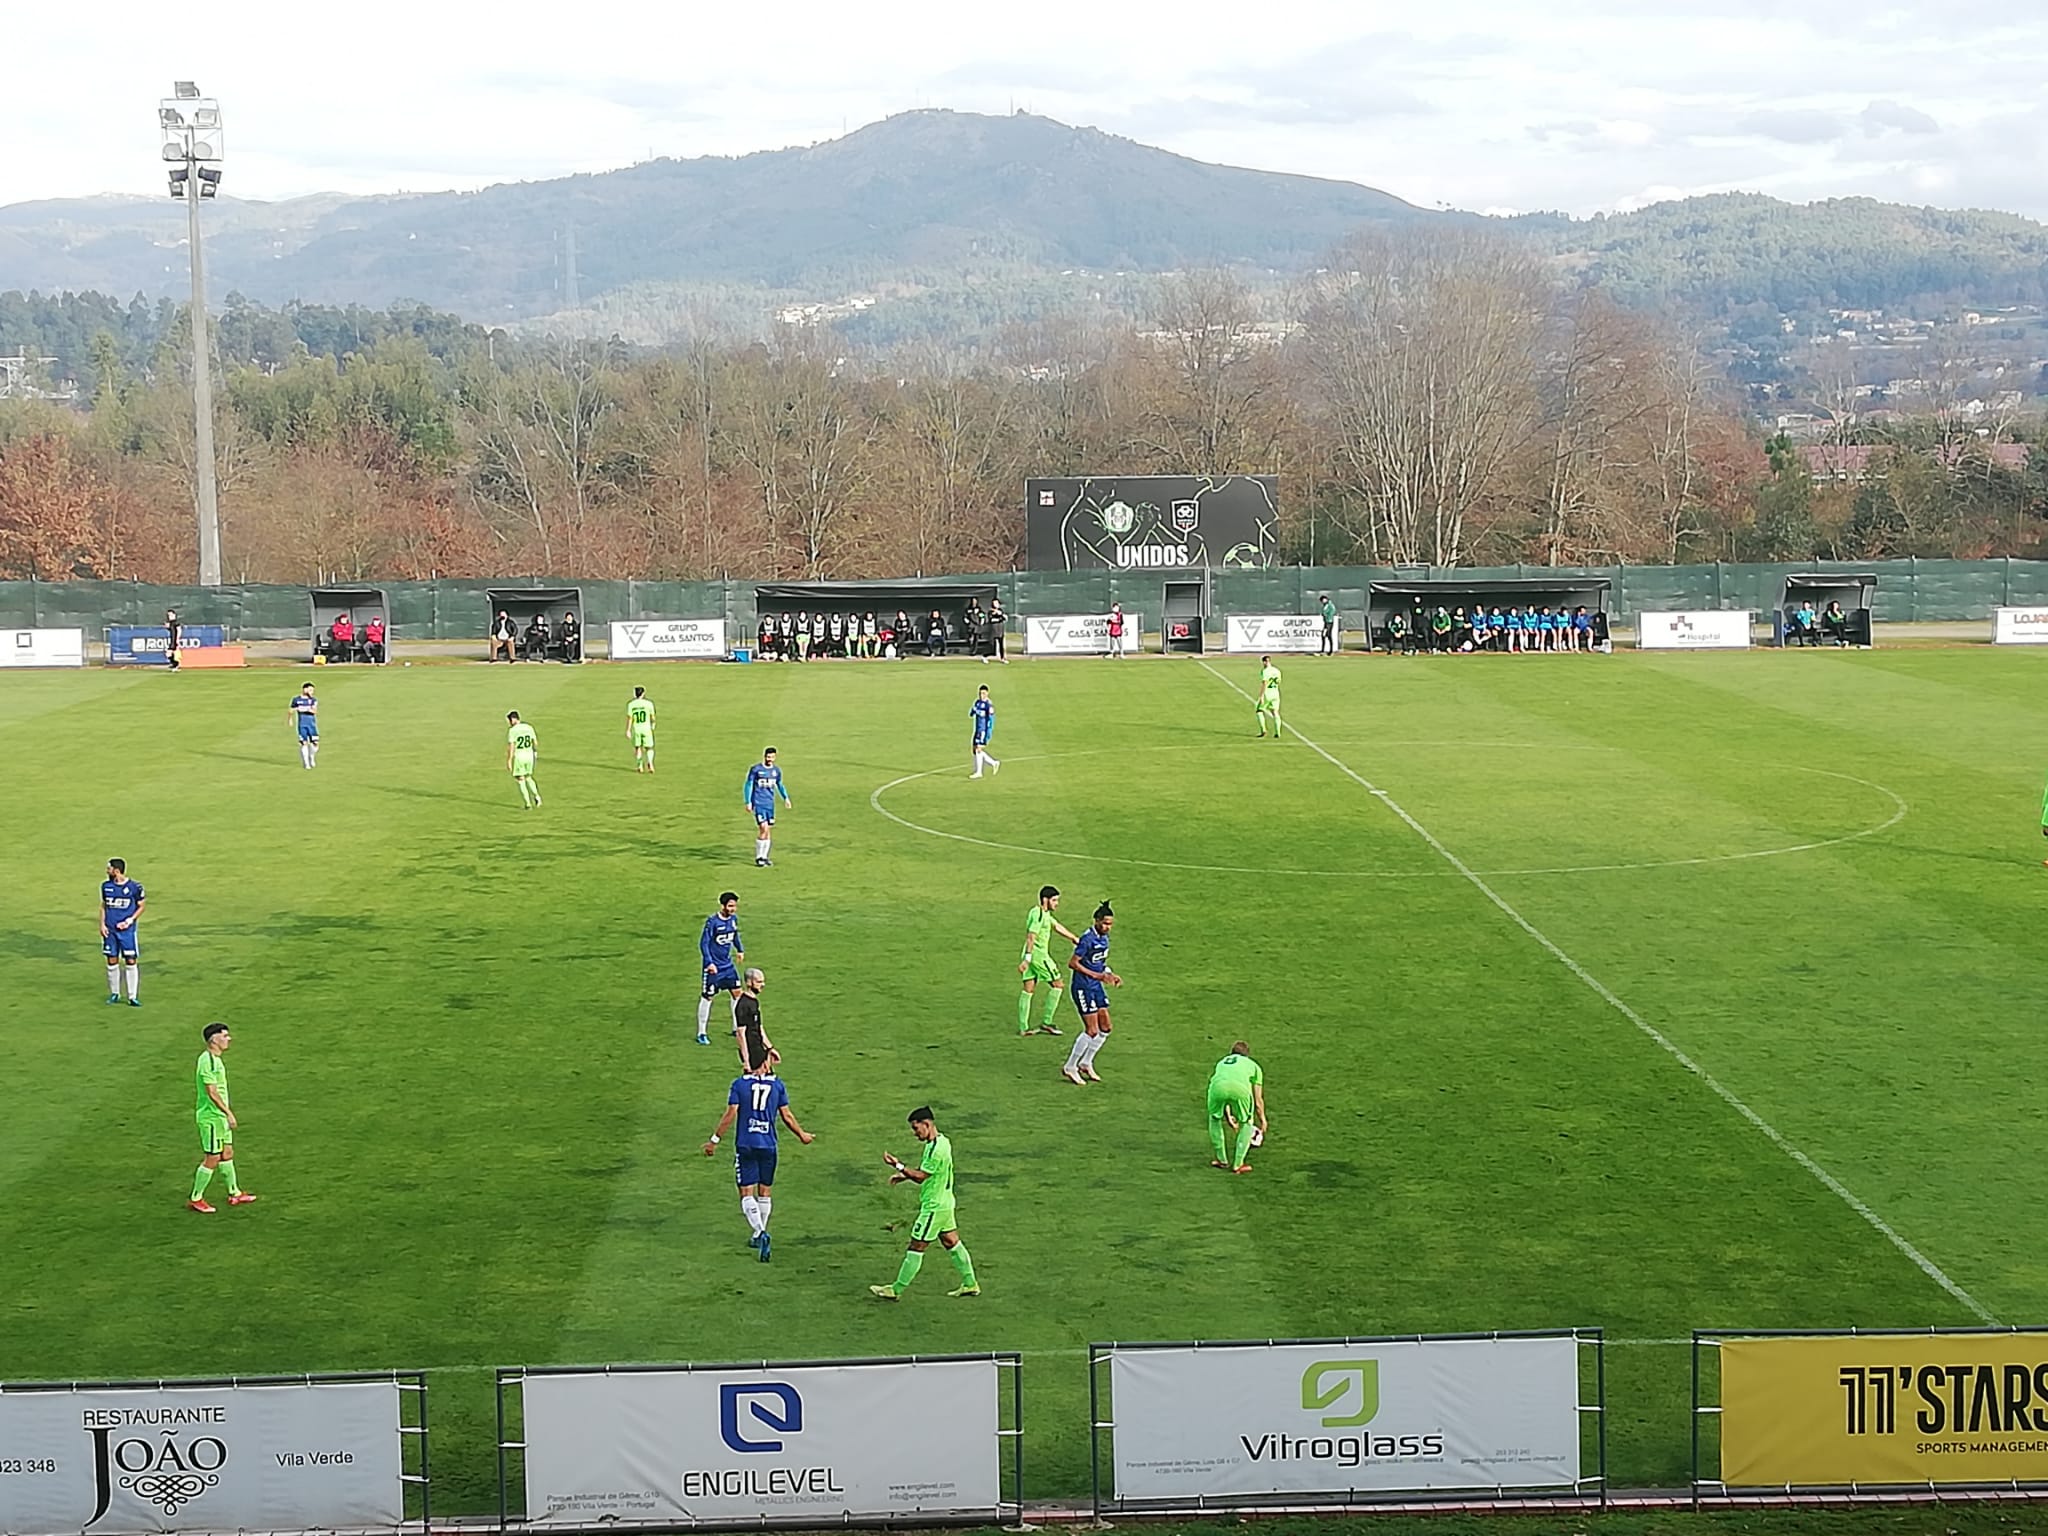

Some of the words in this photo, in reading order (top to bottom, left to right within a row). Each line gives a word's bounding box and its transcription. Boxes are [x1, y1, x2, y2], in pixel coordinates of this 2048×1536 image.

[1116, 544, 1189, 567] UNIDOS
[668, 623, 698, 632] GRUPO
[1083, 618, 1107, 627] GRUP
[1283, 618, 1313, 627] GRUPO
[652, 635, 676, 643] CASA
[678, 633, 715, 643] SANTOS
[1068, 629, 1091, 639] CASA
[1267, 629, 1290, 638] CASA
[1293, 629, 1324, 638] SANTO
[632, 710, 646, 723] 10
[516, 735, 531, 749] 28
[751, 1083, 772, 1110] 17
[83, 1407, 226, 1426] RESTAURANTE
[1240, 1431, 1444, 1467] Vitroglass
[1916, 1442, 1967, 1454] SPORTS
[276, 1452, 304, 1466] Vila
[308, 1450, 353, 1465] Verde
[0, 1459, 22, 1473] 23
[26, 1459, 56, 1473] 348
[683, 1467, 844, 1497] ENGILEVEL
